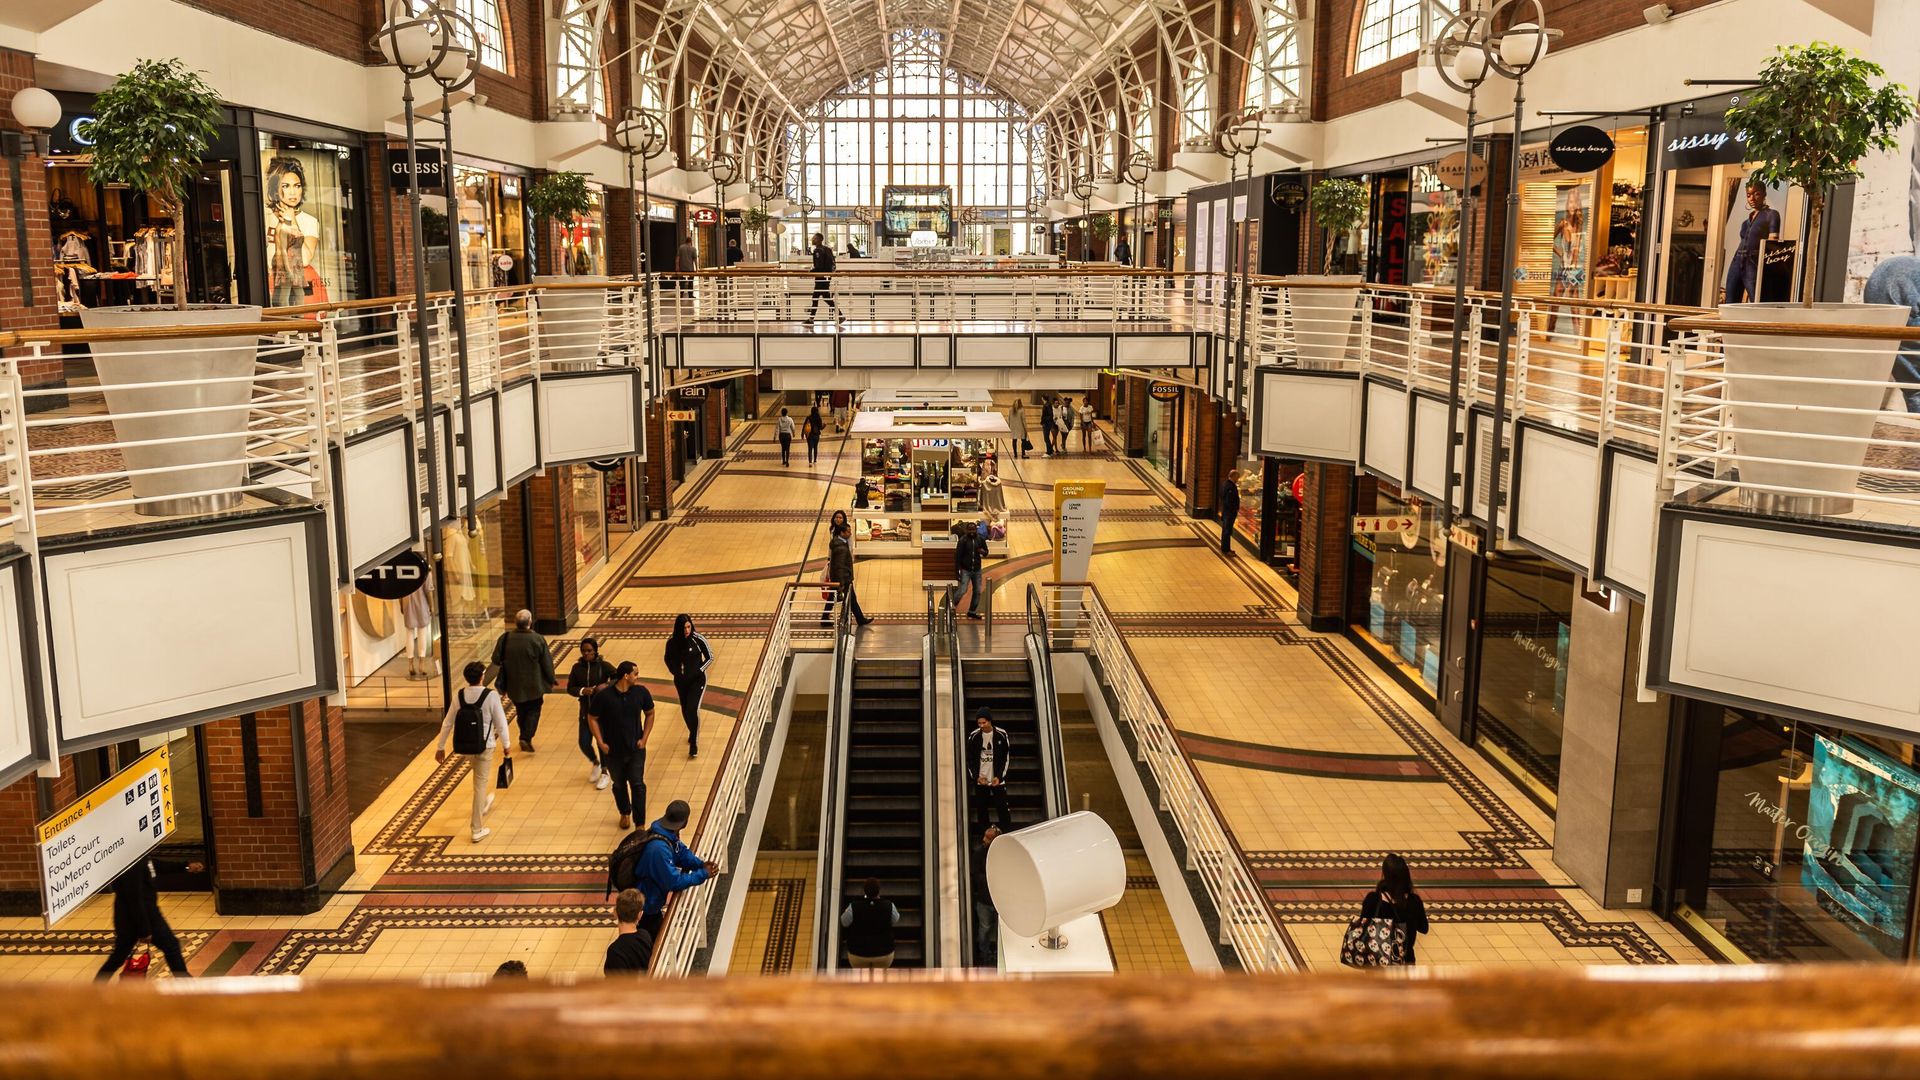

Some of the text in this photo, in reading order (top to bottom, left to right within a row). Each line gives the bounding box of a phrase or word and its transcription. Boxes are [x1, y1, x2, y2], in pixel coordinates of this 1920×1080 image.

[1556, 145, 1608, 153] sissy boy
[1667, 131, 1729, 152] sissy
[392, 162, 440, 174] GUESS
[1388, 197, 1407, 286] SALE
[1764, 245, 1797, 258] sissy
[1766, 254, 1790, 265] boy
[312, 278, 331, 287] GUESS
[680, 385, 706, 396] rain
[44, 800, 91, 840] Entrance 4
[1744, 791, 1844, 867] Master Origin
[46, 834, 76, 860] Toilets
[48, 836, 100, 879] Food Court
[51, 837, 125, 897] NuMetro Cinema
[52, 879, 89, 914] Hamleys
